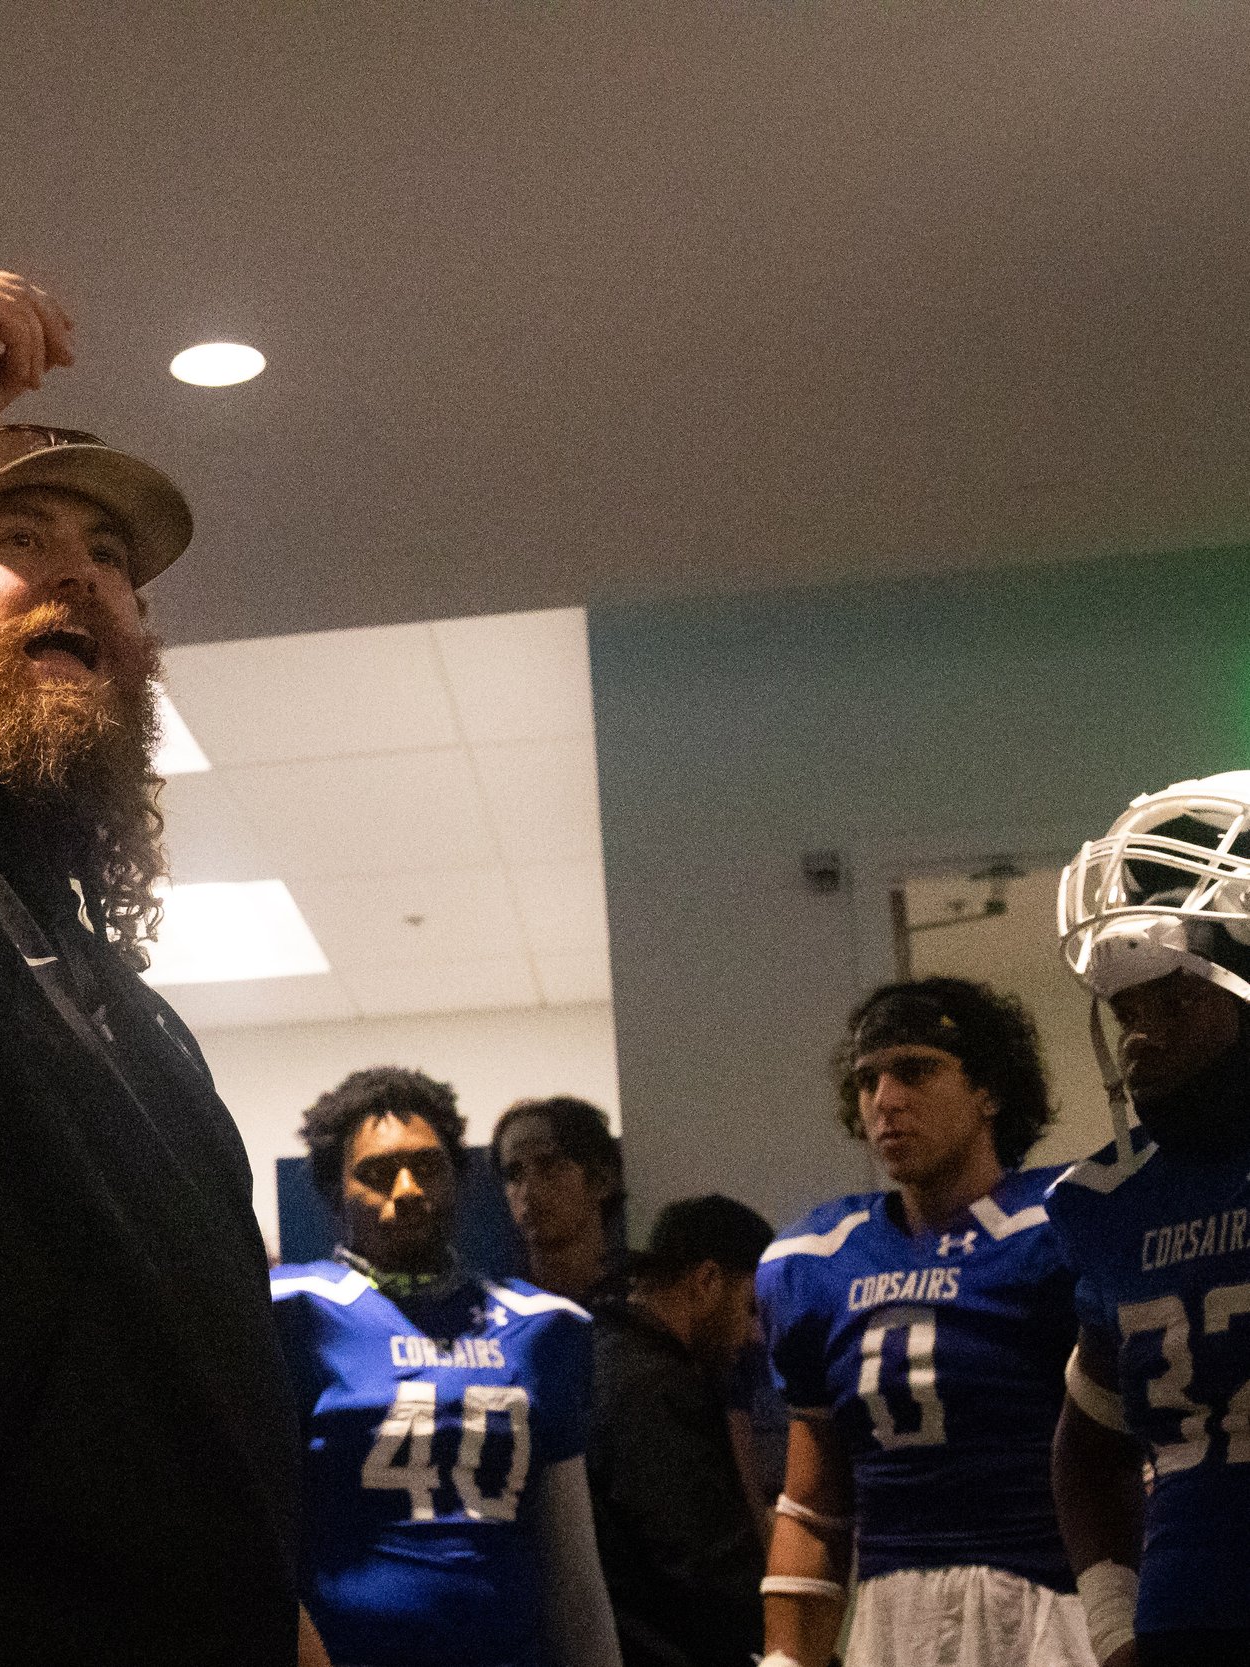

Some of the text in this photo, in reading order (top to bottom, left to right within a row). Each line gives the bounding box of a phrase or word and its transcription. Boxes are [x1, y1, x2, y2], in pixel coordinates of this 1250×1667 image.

[848, 1267, 961, 1311] CORSAIRS
[1141, 1208, 1250, 1272] CORSAIR
[857, 1306, 948, 1451] 0
[360, 1381, 531, 1521] 40
